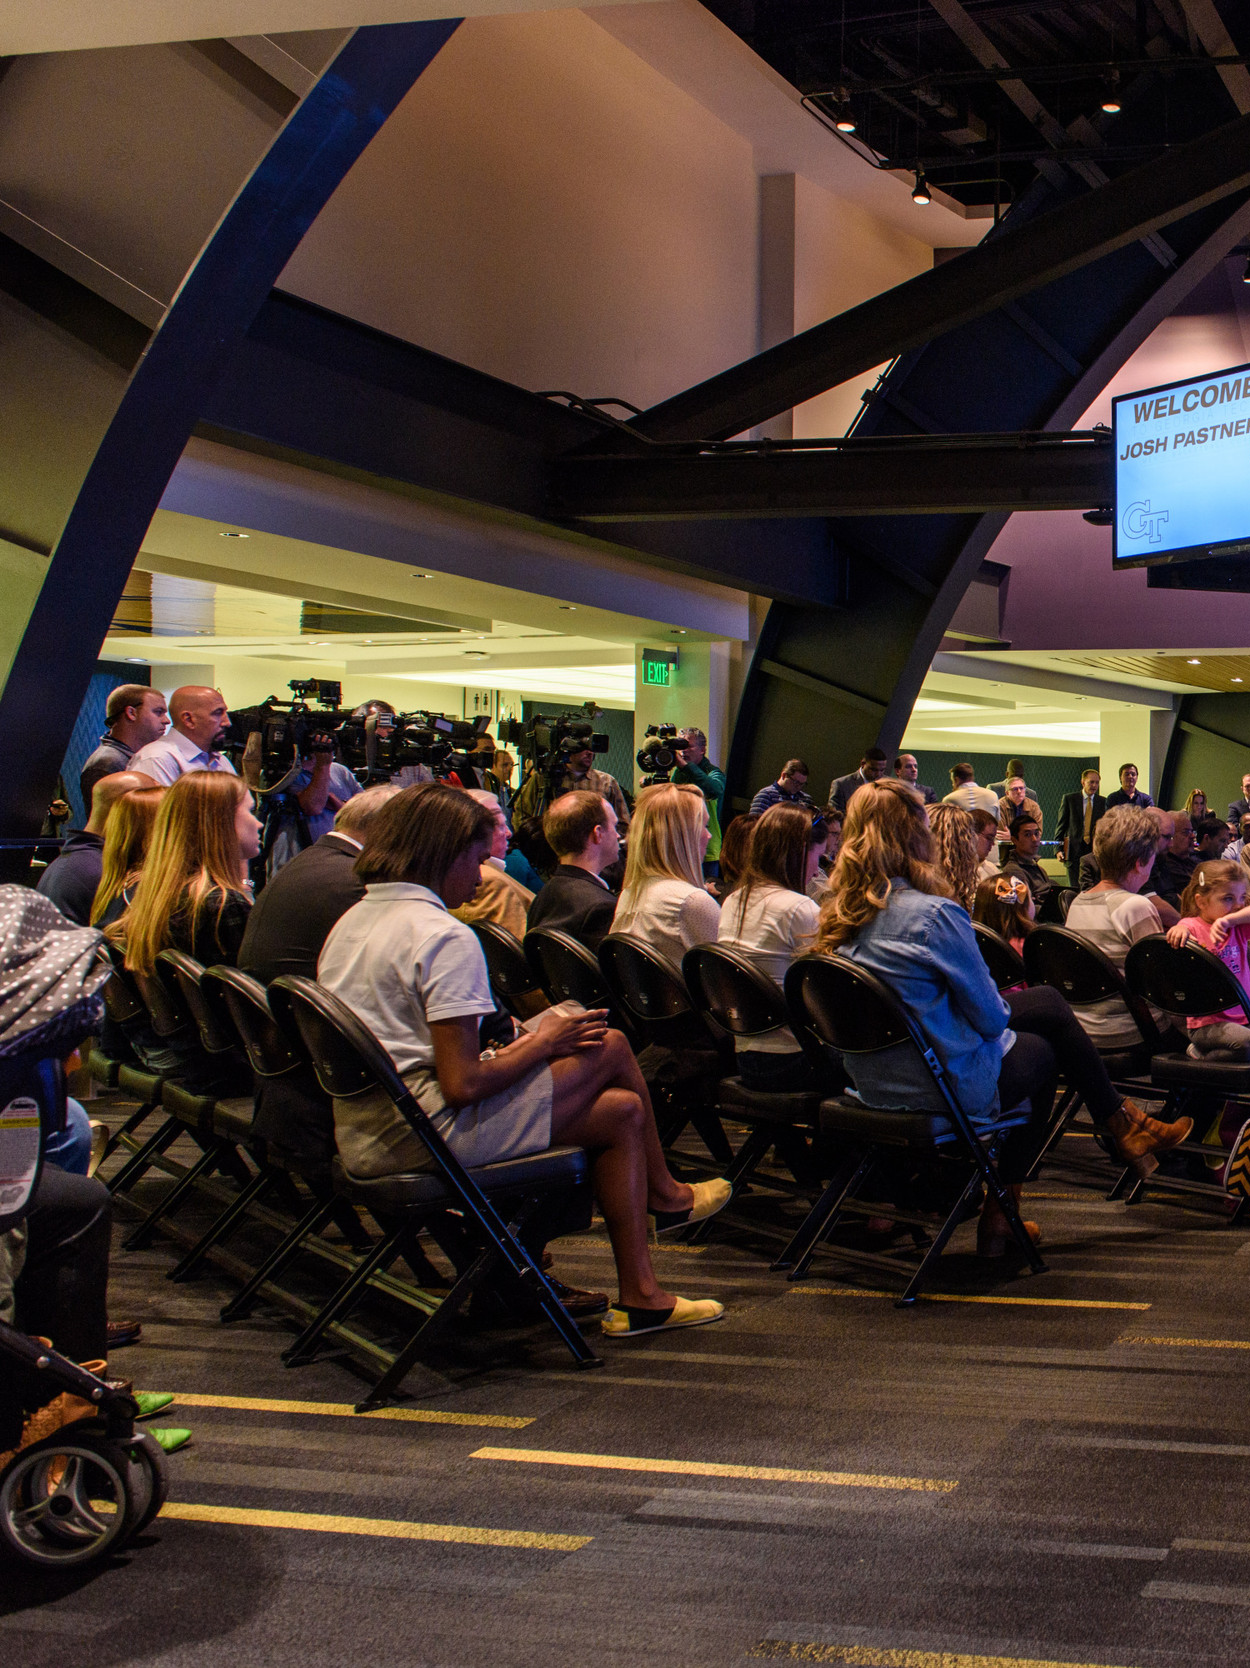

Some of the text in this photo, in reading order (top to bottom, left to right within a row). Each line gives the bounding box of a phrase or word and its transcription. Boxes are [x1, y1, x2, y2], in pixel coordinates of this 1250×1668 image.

[1120, 436, 1168, 461] JOSH
[1122, 499, 1169, 544] GT
[648, 662, 666, 684] EXIT
